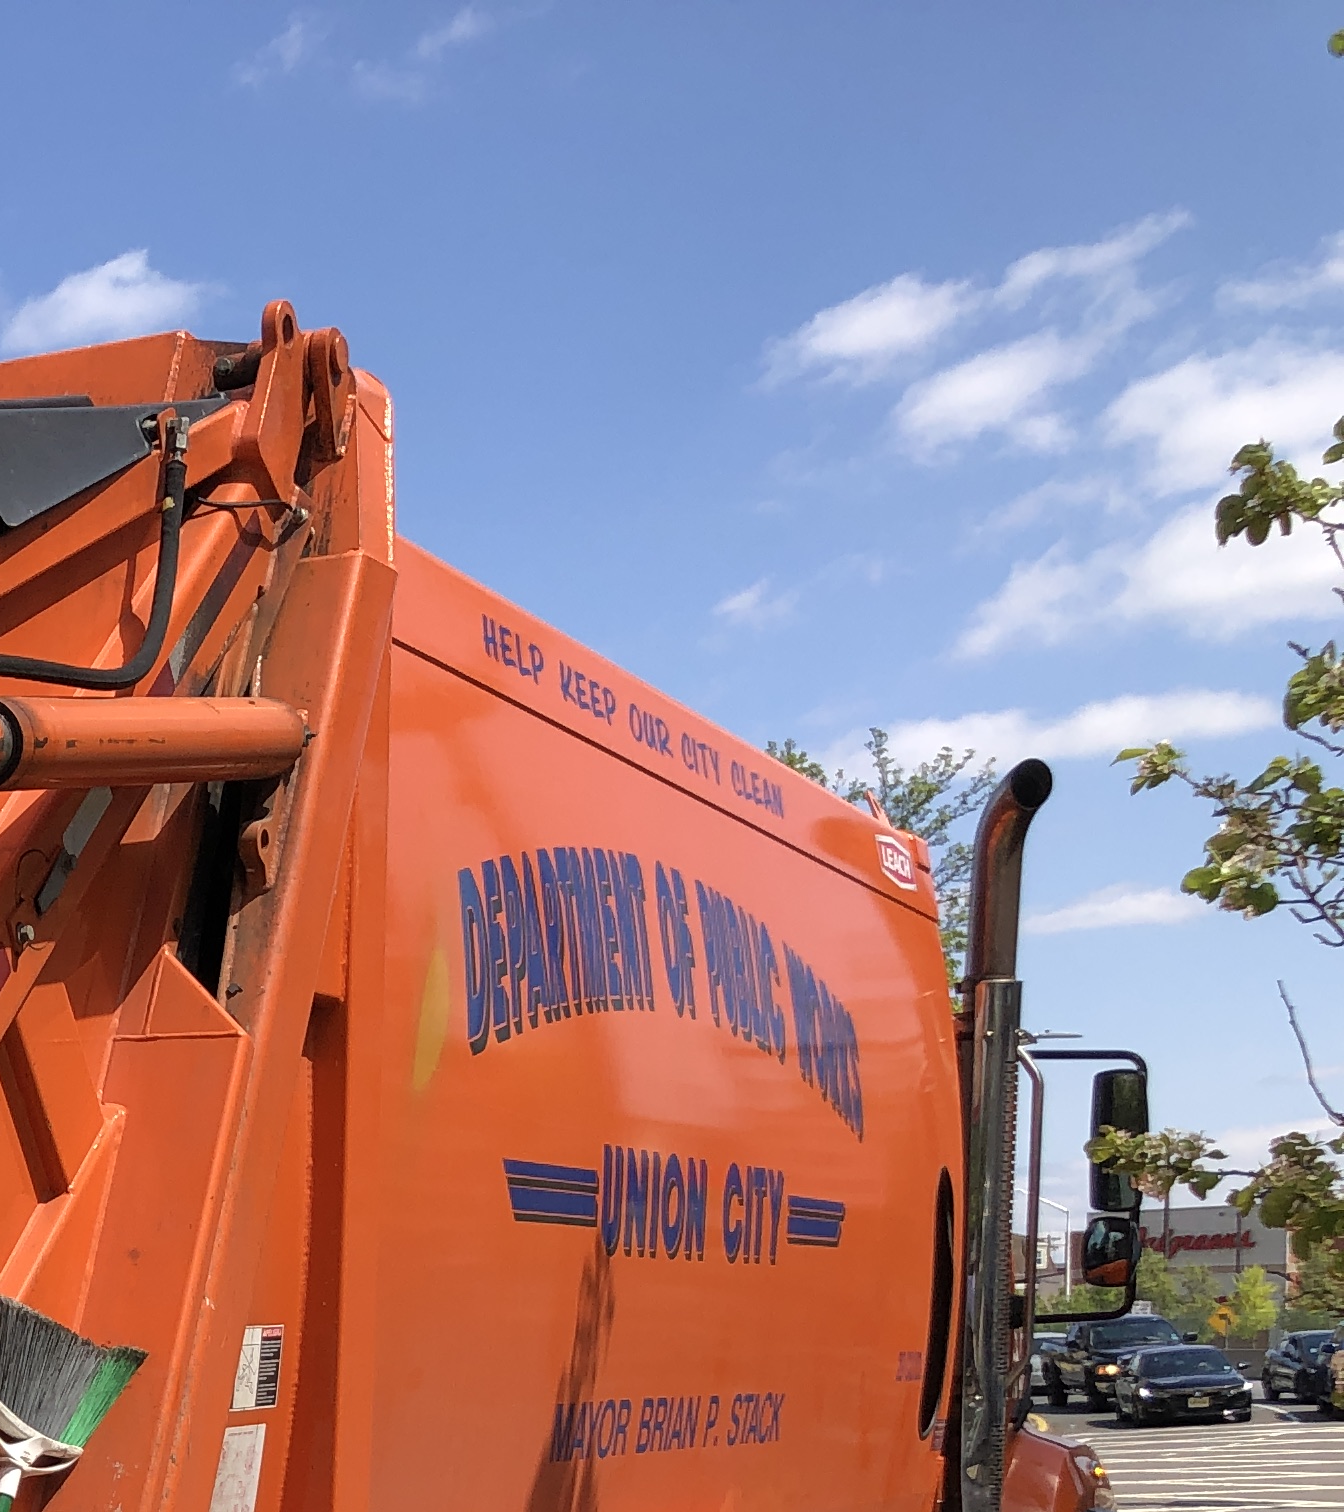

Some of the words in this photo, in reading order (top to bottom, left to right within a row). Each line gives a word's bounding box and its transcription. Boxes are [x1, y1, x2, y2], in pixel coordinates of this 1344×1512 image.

[482, 613, 544, 685] HELP
[559, 660, 616, 726] KEEP
[629, 703, 673, 758] OUR
[681, 732, 721, 785] CITY
[731, 759, 784, 819] CLEAN
[881, 844, 911, 879] LEACH
[458, 847, 655, 1056] DEPARTMENT
[655, 860, 697, 1020] OF
[695, 879, 786, 1065] PUBLIC
[602, 1143, 708, 1261] UNION
[723, 1162, 785, 1266] CITY
[549, 1399, 632, 1462] MAYOR
[635, 1395, 701, 1454] BRIAN
[703, 1395, 719, 1448] P.
[727, 1392, 786, 1446] STACK
